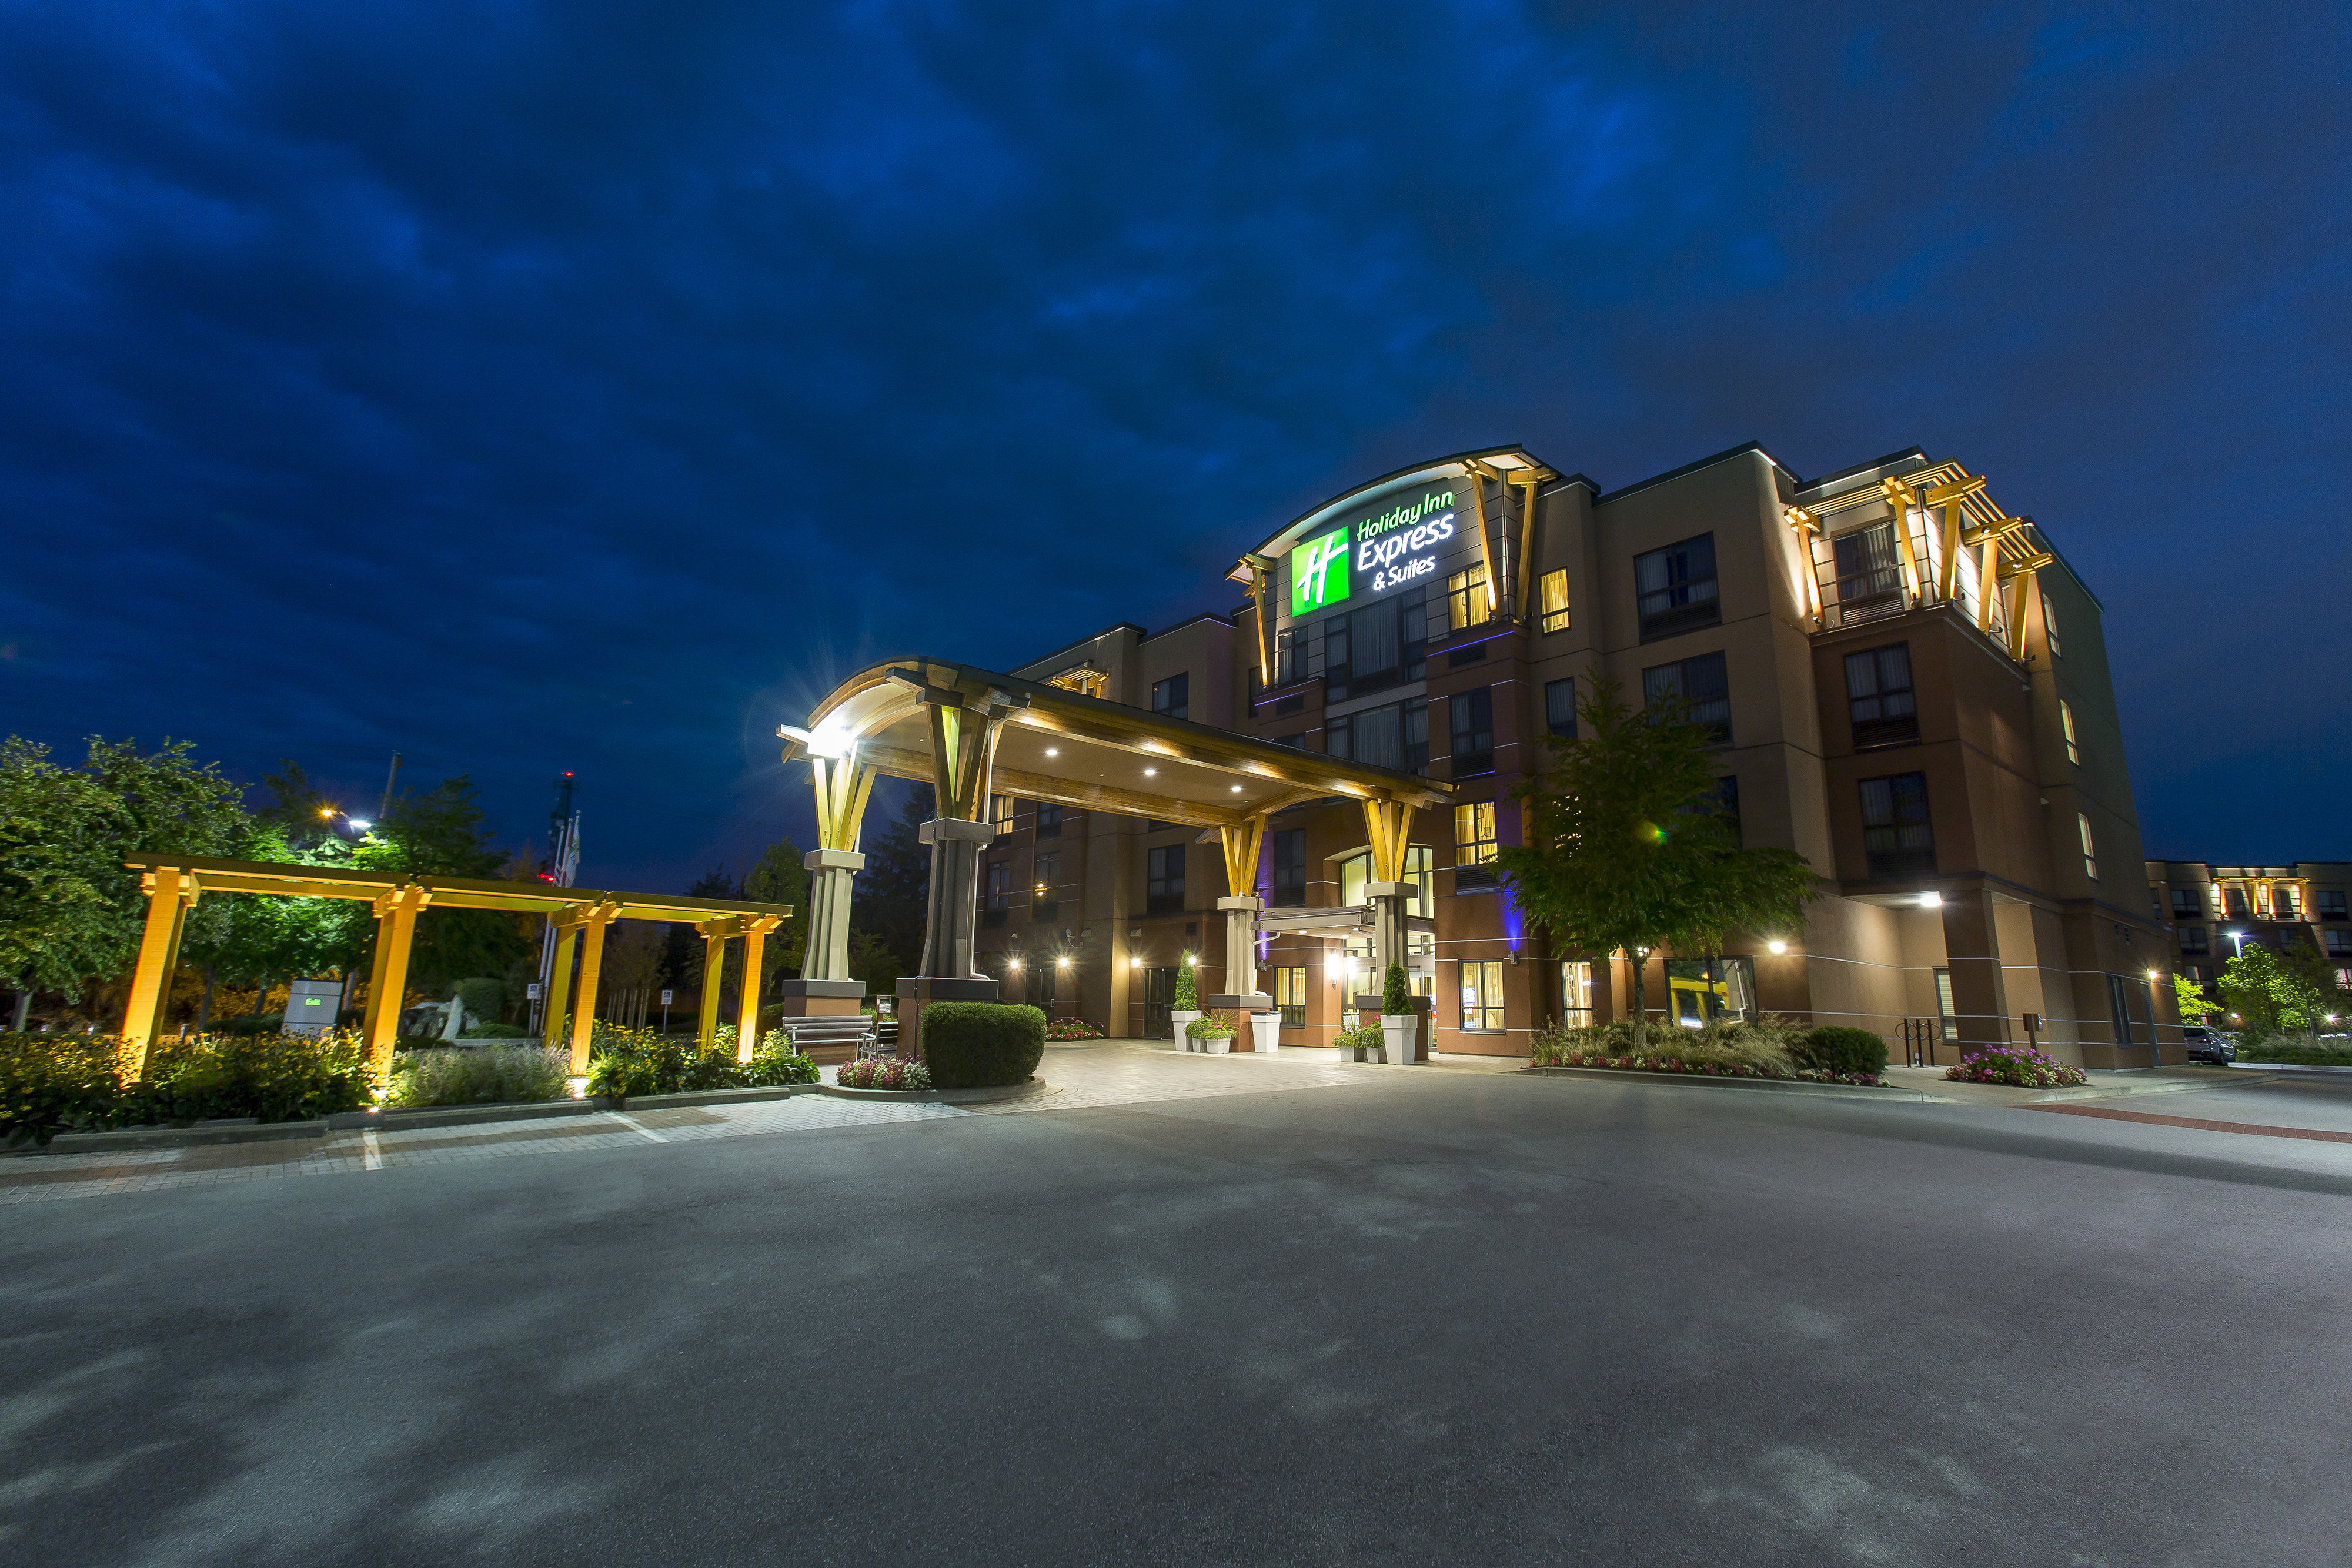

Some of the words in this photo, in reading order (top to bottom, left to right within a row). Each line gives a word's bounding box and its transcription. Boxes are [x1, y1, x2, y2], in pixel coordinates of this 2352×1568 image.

[1357, 503, 1421, 541] Holiday
[1424, 491, 1455, 514] Inn
[1358, 514, 1454, 571] Express
[1373, 571, 1385, 591] &
[1387, 556, 1435, 586] Suites
